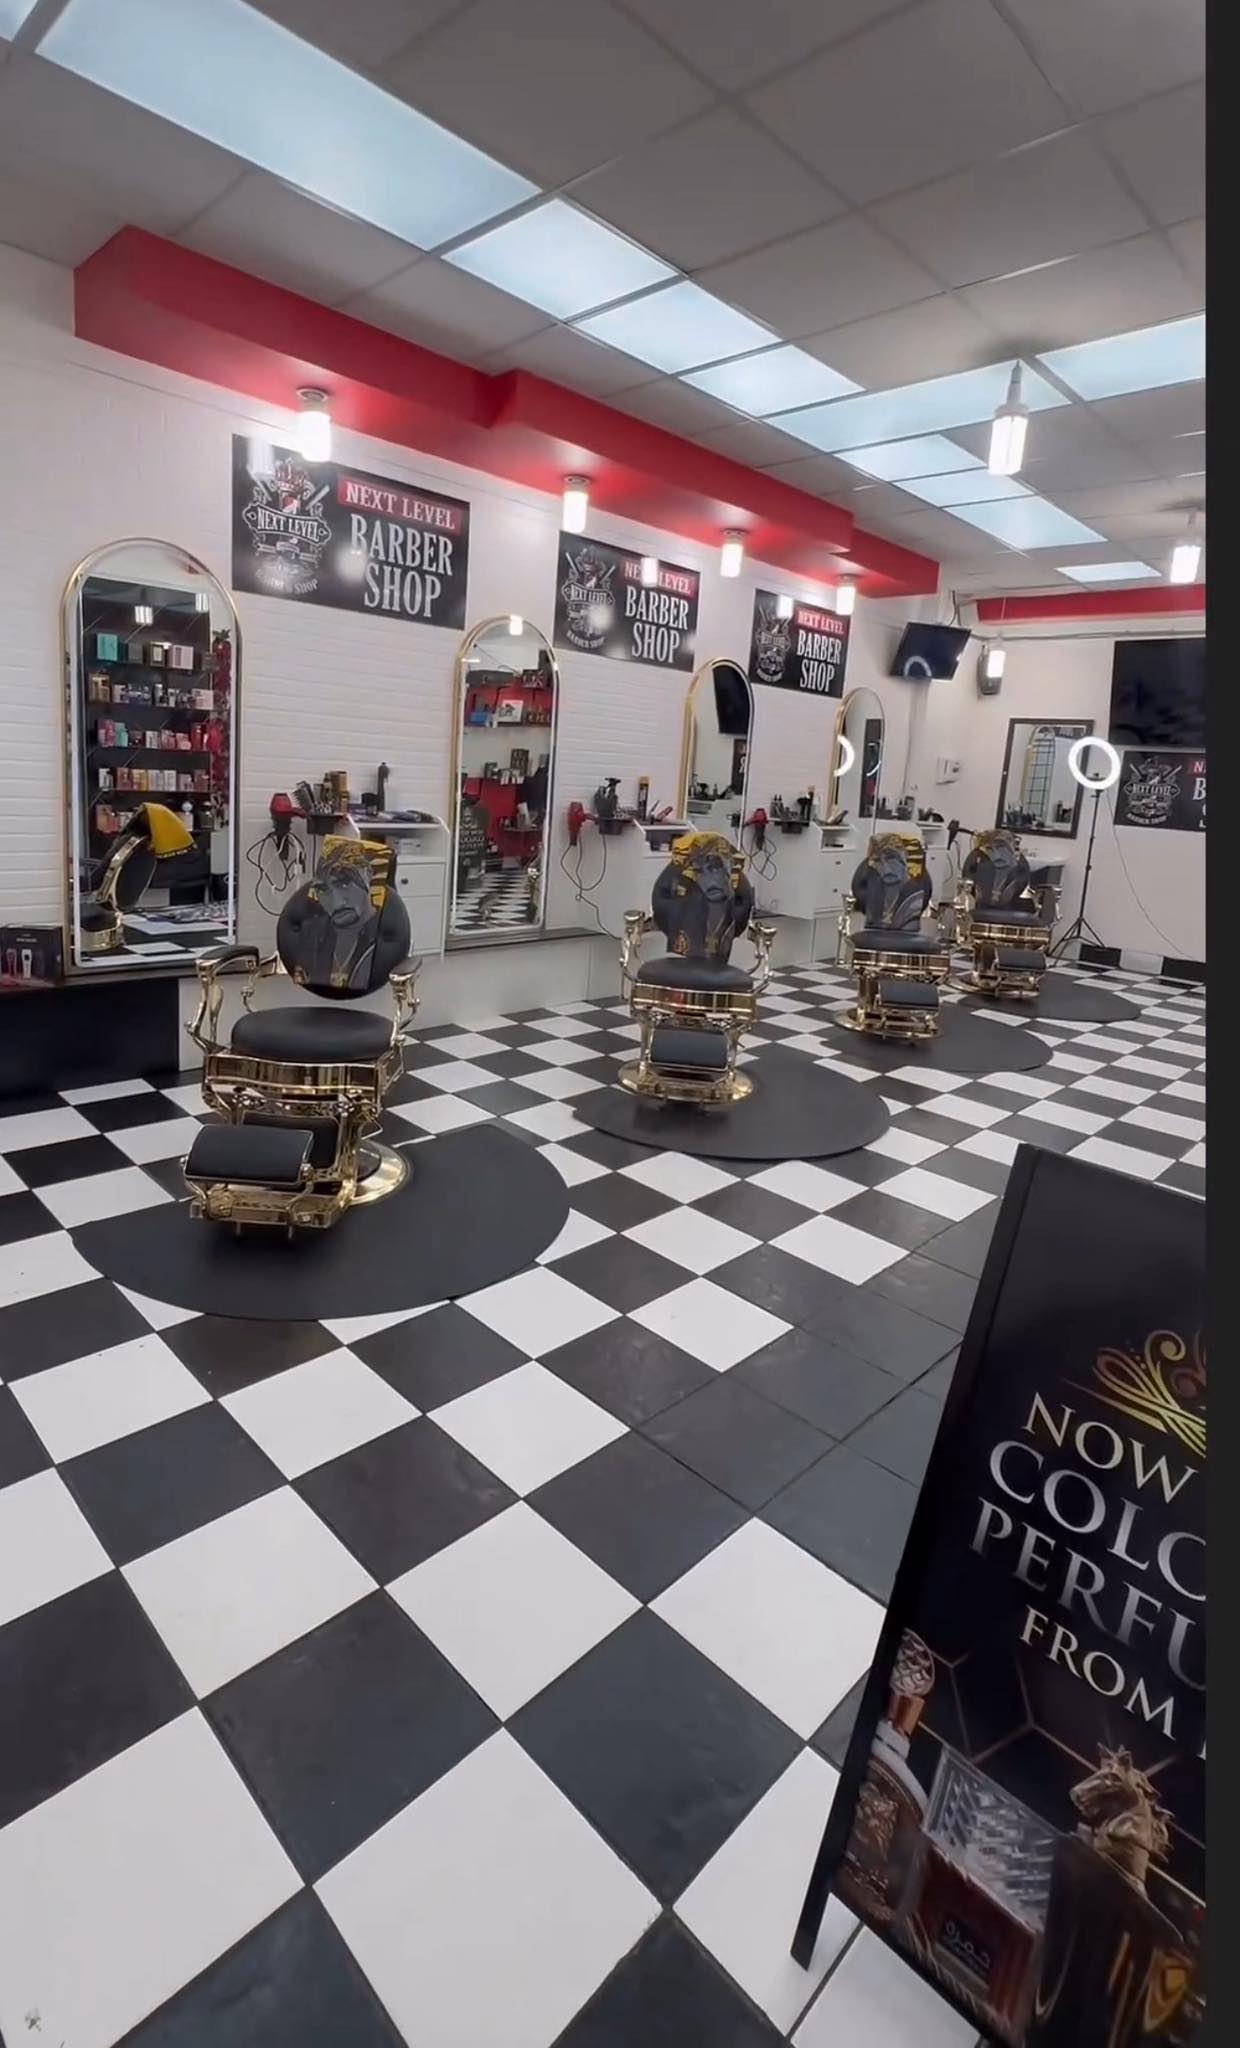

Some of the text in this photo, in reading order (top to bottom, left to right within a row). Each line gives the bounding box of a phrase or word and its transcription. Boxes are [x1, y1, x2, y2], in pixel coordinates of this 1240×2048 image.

[257, 507, 320, 542] NEXT LEVEL
[346, 481, 456, 530] NEXT LEVEL
[350, 513, 454, 576] BARBER
[364, 562, 442, 618] SHOP
[658, 570, 691, 594] LEVEL
[625, 585, 689, 631] BARBER
[631, 622, 681, 664] SHOP
[796, 629, 842, 666] BARBER
[799, 659, 835, 693] SHOP
[1021, 1391, 1200, 1504] NOW
[1018, 1603, 1178, 1741] FROM
